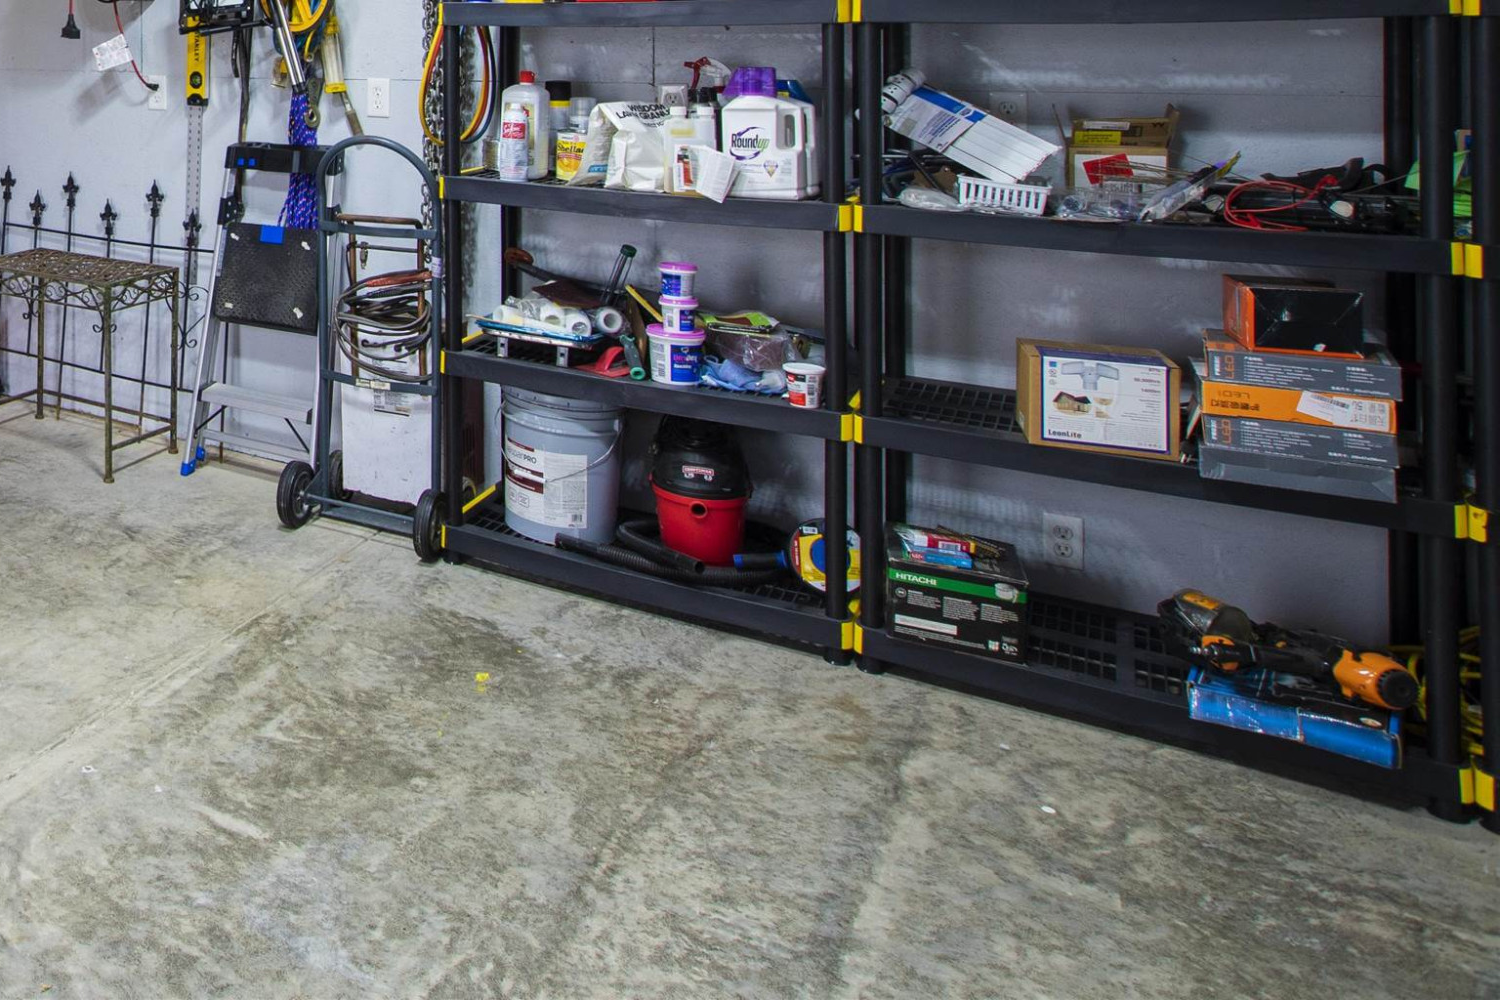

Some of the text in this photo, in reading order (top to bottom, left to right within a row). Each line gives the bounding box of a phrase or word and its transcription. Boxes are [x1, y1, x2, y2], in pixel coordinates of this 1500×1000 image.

[628, 102, 667, 113] WISDOM
[557, 142, 584, 154] Shella
[731, 134, 770, 152] Roundup
[1048, 429, 1082, 439] LeonLite
[895, 572, 938, 586] HITACHI
